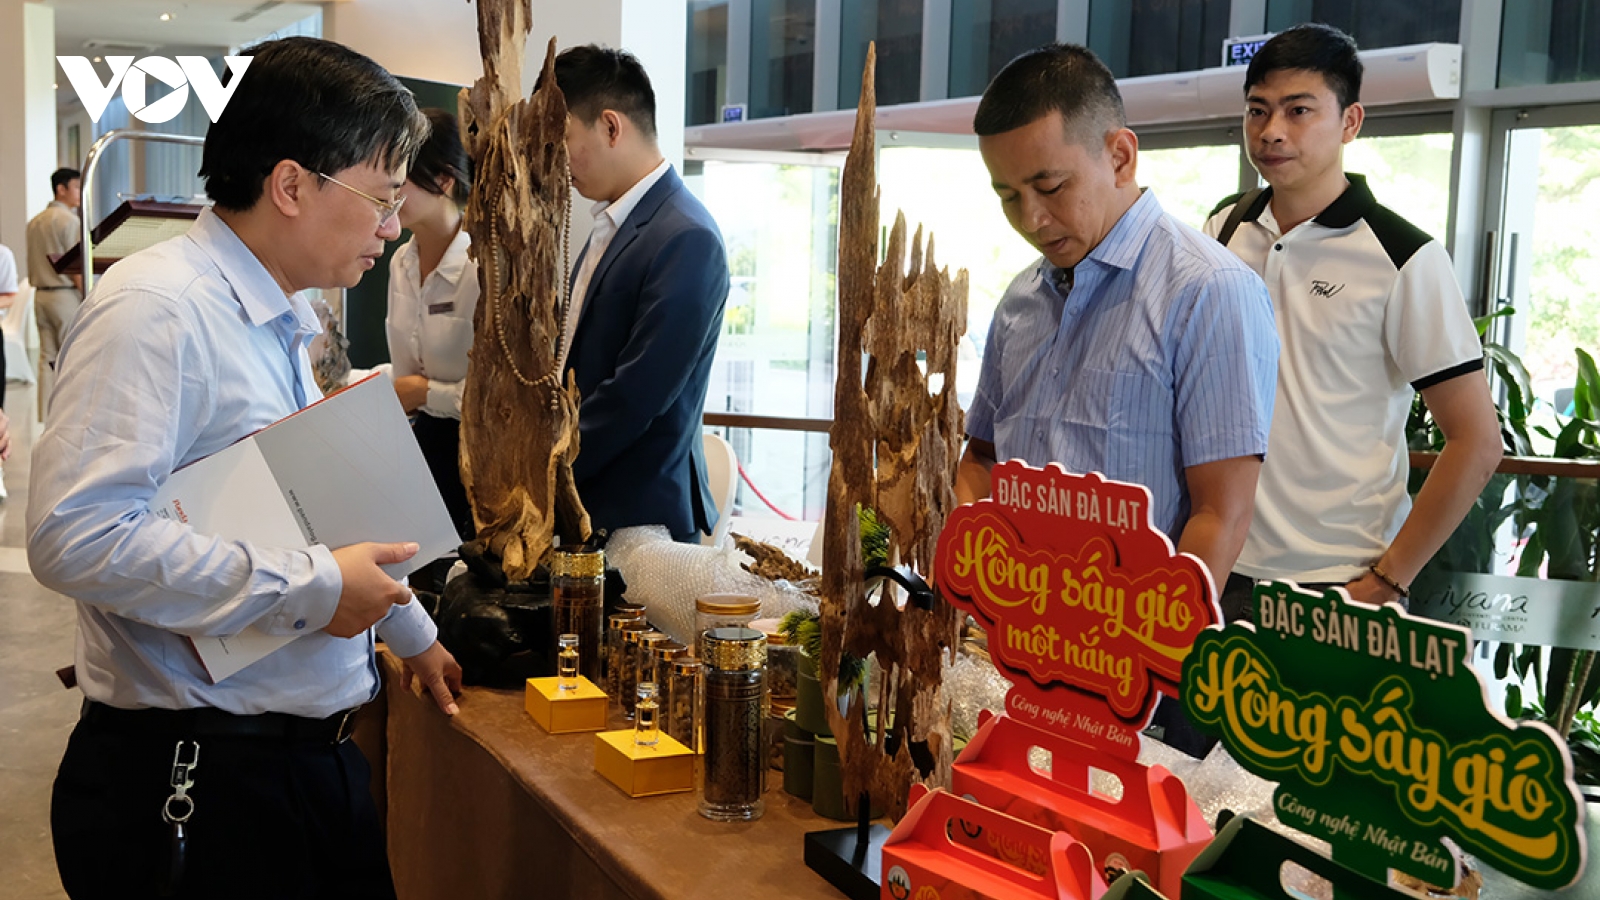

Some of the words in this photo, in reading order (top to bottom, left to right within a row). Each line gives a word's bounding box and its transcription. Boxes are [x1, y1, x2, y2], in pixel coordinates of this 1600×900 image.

[998, 475, 1031, 513] ĐẶC
[1037, 478, 1072, 518] SẢN
[1077, 489, 1101, 523] ĐÀ
[1107, 498, 1140, 534] LẠT
[953, 526, 1052, 615] Hồng
[1060, 552, 1126, 638] sấy
[1135, 582, 1195, 646] gió
[1007, 625, 1060, 664] một
[1064, 625, 1134, 697] nắng
[1259, 593, 1305, 639] ĐẶC
[1311, 600, 1359, 651] SẢN
[1367, 617, 1402, 663] ĐÀ
[1409, 630, 1459, 680] LẠT
[1011, 694, 1039, 718] Công
[1041, 707, 1070, 726] nghệ
[1073, 713, 1104, 739] Nhật
[1106, 724, 1133, 747] Bản
[1194, 647, 1331, 774] Hồng
[1339, 687, 1441, 812] sấy
[1453, 748, 1553, 830] gió
[1278, 792, 1316, 826] Công
[1319, 813, 1360, 841] nghệ
[1363, 823, 1408, 857] Nhật
[1410, 840, 1449, 873] Bản
